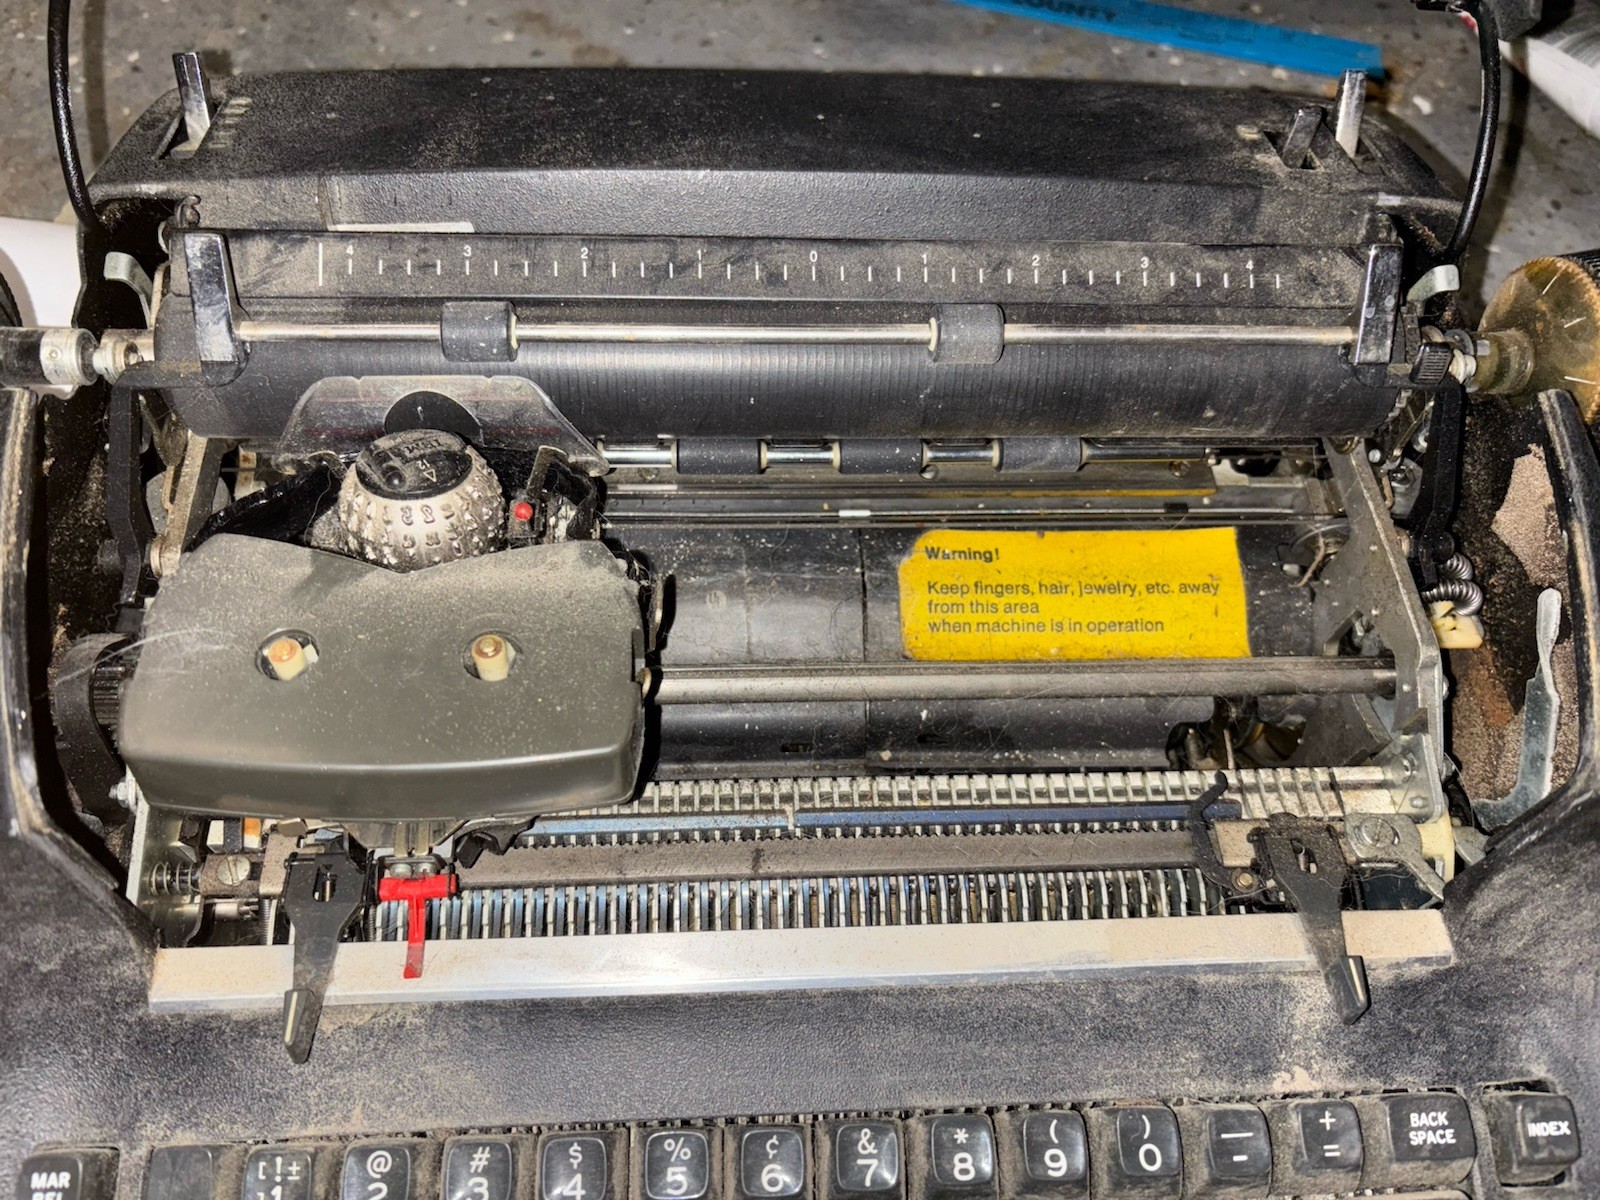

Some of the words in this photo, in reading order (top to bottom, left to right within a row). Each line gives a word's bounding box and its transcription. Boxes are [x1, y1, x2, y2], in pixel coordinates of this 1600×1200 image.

[346, 245, 354, 256] 4
[463, 245, 471, 257] 3
[580, 248, 589, 259] 2
[697, 249, 703, 260] 1
[809, 251, 818, 263] 0
[921, 254, 927, 265] 1
[1031, 254, 1040, 267] 2
[1140, 256, 1149, 269] 3
[1246, 259, 1254, 270] 4
[925, 545, 999, 563] Warning!
[928, 581, 970, 597] Keep
[974, 580, 1035, 597] fingers,
[1038, 581, 1075, 596] hair,
[1078, 580, 1142, 597] jewelry,
[1145, 582, 1174, 594] etc.
[1178, 583, 1220, 596] away
[928, 600, 965, 614] from
[970, 600, 999, 614] this
[1003, 602, 1040, 614] area
[928, 619, 972, 633] when
[976, 619, 1046, 633] machine
[1050, 619, 1064, 632] is
[1068, 619, 1083, 632] in
[1086, 618, 1164, 635] operation
[1143, 1114, 1151, 1139] )
[1318, 1111, 1336, 1130] +
[1410, 1111, 1449, 1129] BACK
[1528, 1121, 1571, 1137] INDEX
[1049, 1118, 1057, 1144] (
[1409, 1128, 1456, 1146] SPACE
[664, 1138, 692, 1162] %
[857, 1127, 876, 1155] &
[469, 1146, 491, 1174] #
[568, 1141, 583, 1170] $
[1138, 1142, 1163, 1172] 0
[1324, 1144, 1341, 1158] =
[366, 1150, 393, 1179] @
[952, 1151, 977, 1181] 8
[1043, 1149, 1068, 1177] 9
[30, 1171, 71, 1190] MAR
[665, 1166, 688, 1195] 5
[759, 1163, 784, 1192] 6
[855, 1158, 879, 1188] 7
[366, 1181, 389, 1200] 2
[465, 1176, 490, 1200] 3
[561, 1173, 586, 1200] 4
